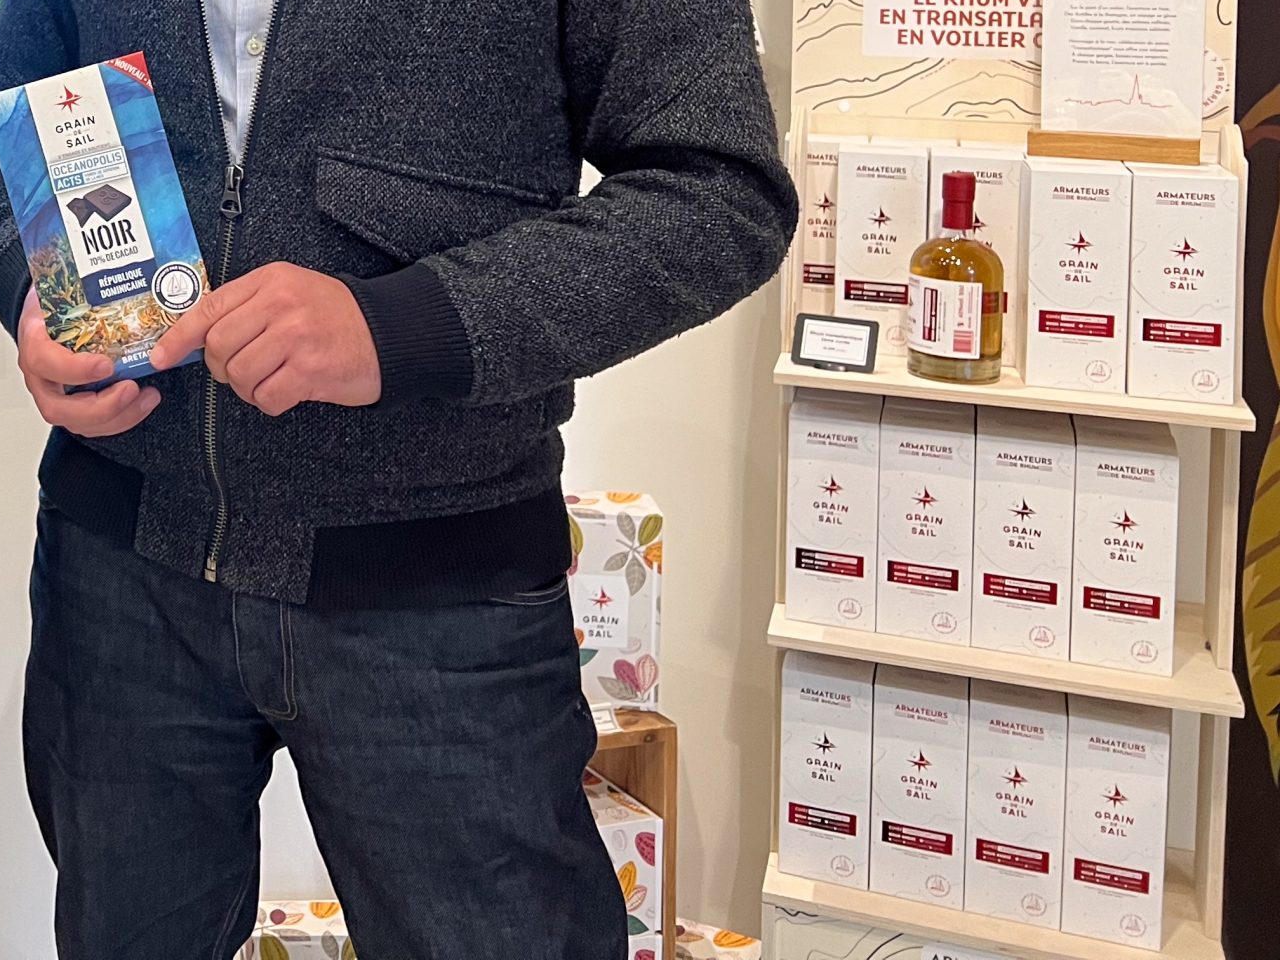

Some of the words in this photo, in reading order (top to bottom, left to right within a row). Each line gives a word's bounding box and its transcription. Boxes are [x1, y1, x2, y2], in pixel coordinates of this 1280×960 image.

[879, 8, 906, 25] EN
[897, 28, 923, 45] EN
[930, 29, 1025, 48] VOILIER
[114, 59, 146, 81] NOUVEAU
[55, 115, 96, 134] GRAIN
[66, 133, 95, 148] SAIL
[53, 151, 122, 177] OCEANOPOLIS
[856, 165, 907, 175] ARMATEURS
[57, 174, 82, 190] ACTS
[1053, 186, 1110, 196] ARMATEURS
[1156, 191, 1216, 201] ARMATEURS
[81, 219, 137, 256] NOIR
[861, 233, 897, 243] GRAIN
[89, 256, 105, 267] 70%
[105, 252, 115, 262] DE
[114, 245, 139, 259] CACAO
[867, 246, 891, 255] SAIL
[1059, 260, 1099, 270] GRAIN
[98, 267, 144, 288] RÉPUBLIQUE
[1064, 274, 1092, 283] SAIL
[1163, 267, 1205, 278] GRAIN
[100, 277, 148, 299] DOMINICAINE
[1169, 281, 1198, 291] SAIL
[807, 431, 858, 443] ARMATEURS
[899, 442, 953, 454] ARMATEURS
[997, 452, 1053, 465] ARMATEURS
[1097, 463, 1155, 477] ARMATEURS
[812, 501, 849, 513] GRAIN
[818, 515, 843, 525] SAIL
[905, 513, 943, 525] GRAIN
[911, 527, 937, 537] SAIL
[1003, 525, 1042, 538] GRAIN
[1008, 540, 1035, 550] SAIL
[1104, 538, 1144, 550] GRAIN
[1109, 552, 1137, 563] SAIL
[583, 615, 619, 625] GRAIN
[588, 629, 613, 638] SAIL
[800, 687, 852, 702] ARMATEURS
[895, 704, 948, 719] ARMATEURS
[989, 719, 1045, 735] ARMATEURS
[1089, 736, 1146, 753] ARMATEURS
[806, 757, 842, 771] GRAIN
[811, 771, 836, 782] SAIL
[900, 775, 938, 789] GRAIN
[905, 789, 932, 800] SAIL
[995, 792, 1034, 806] GRAIN
[1001, 806, 1028, 818] SAIL
[1094, 811, 1135, 825] GRAIN
[1100, 825, 1128, 837] SAIL
